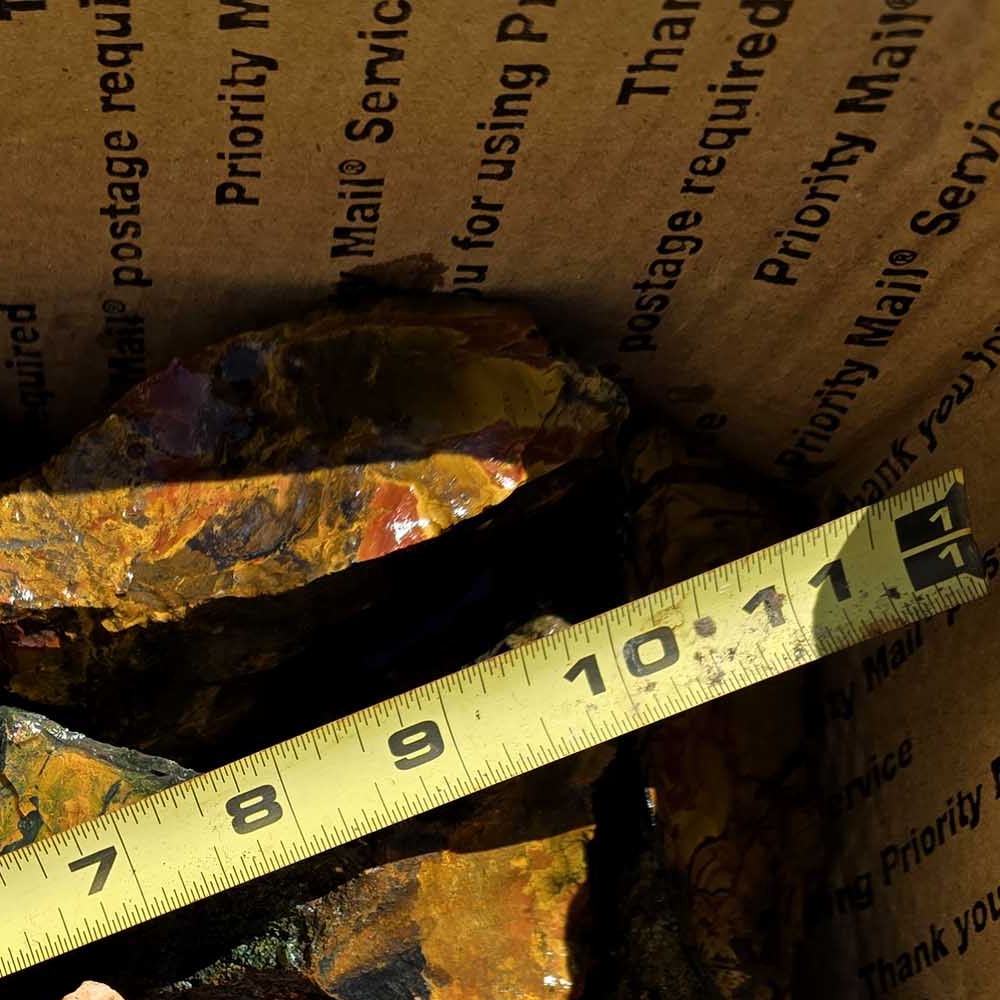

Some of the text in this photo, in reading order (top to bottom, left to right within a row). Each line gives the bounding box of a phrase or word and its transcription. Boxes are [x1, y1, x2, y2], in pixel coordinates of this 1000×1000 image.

[215, 48, 280, 206] Priority
[475, 63, 551, 183] using
[617, 0, 795, 353] postage required
[99, 129, 153, 287] postage
[329, 158, 385, 258] Mail®
[450, 195, 505, 251] for
[752, 131, 878, 287] Priority
[773, 358, 880, 470] Priority
[67, 845, 118, 896] 7
[224, 783, 284, 836] 8
[387, 718, 446, 771] 9
[879, 783, 983, 888] Priority
